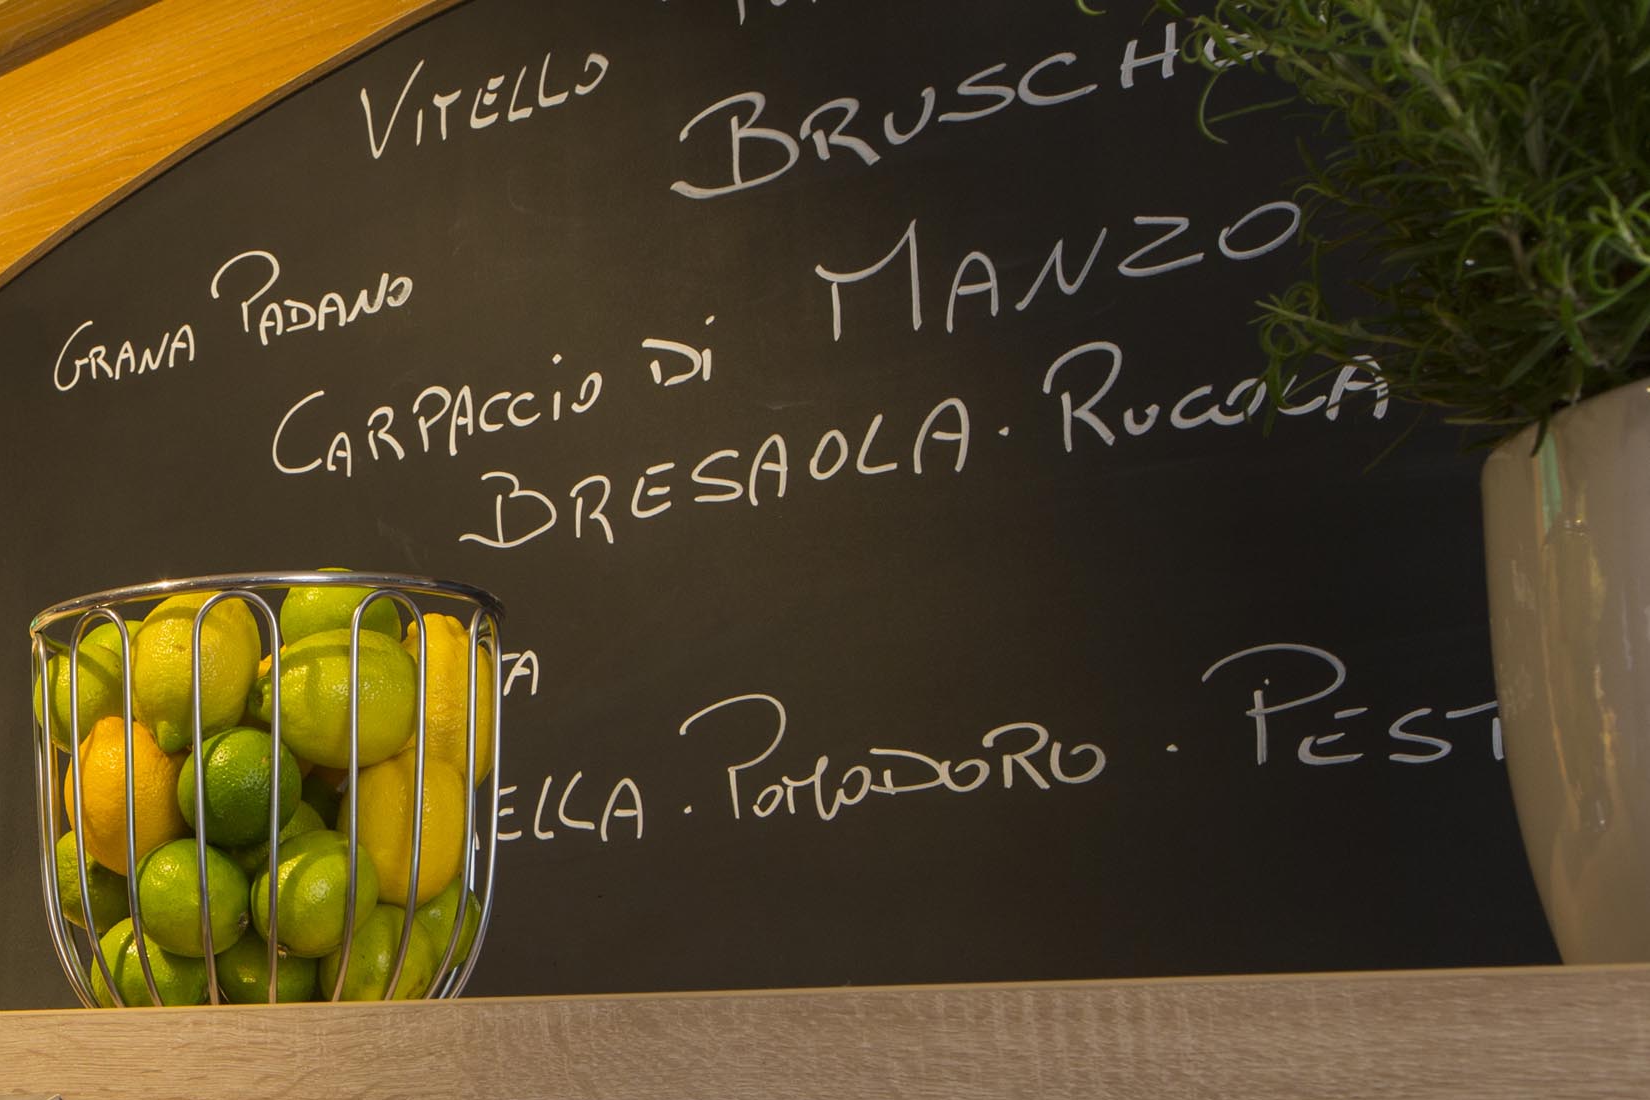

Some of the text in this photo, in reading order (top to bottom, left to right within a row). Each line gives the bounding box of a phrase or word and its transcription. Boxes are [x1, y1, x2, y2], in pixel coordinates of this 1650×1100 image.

[360, 52, 609, 160] VITELLO
[670, 4, 1266, 200] BRUSCHE
[53, 249, 414, 393] GRANA PADANO
[814, 200, 1302, 345] MANZO
[458, 397, 971, 549] BRESAOLA
[498, 766, 645, 843] ELLA
[1201, 642, 1507, 767] PEST
